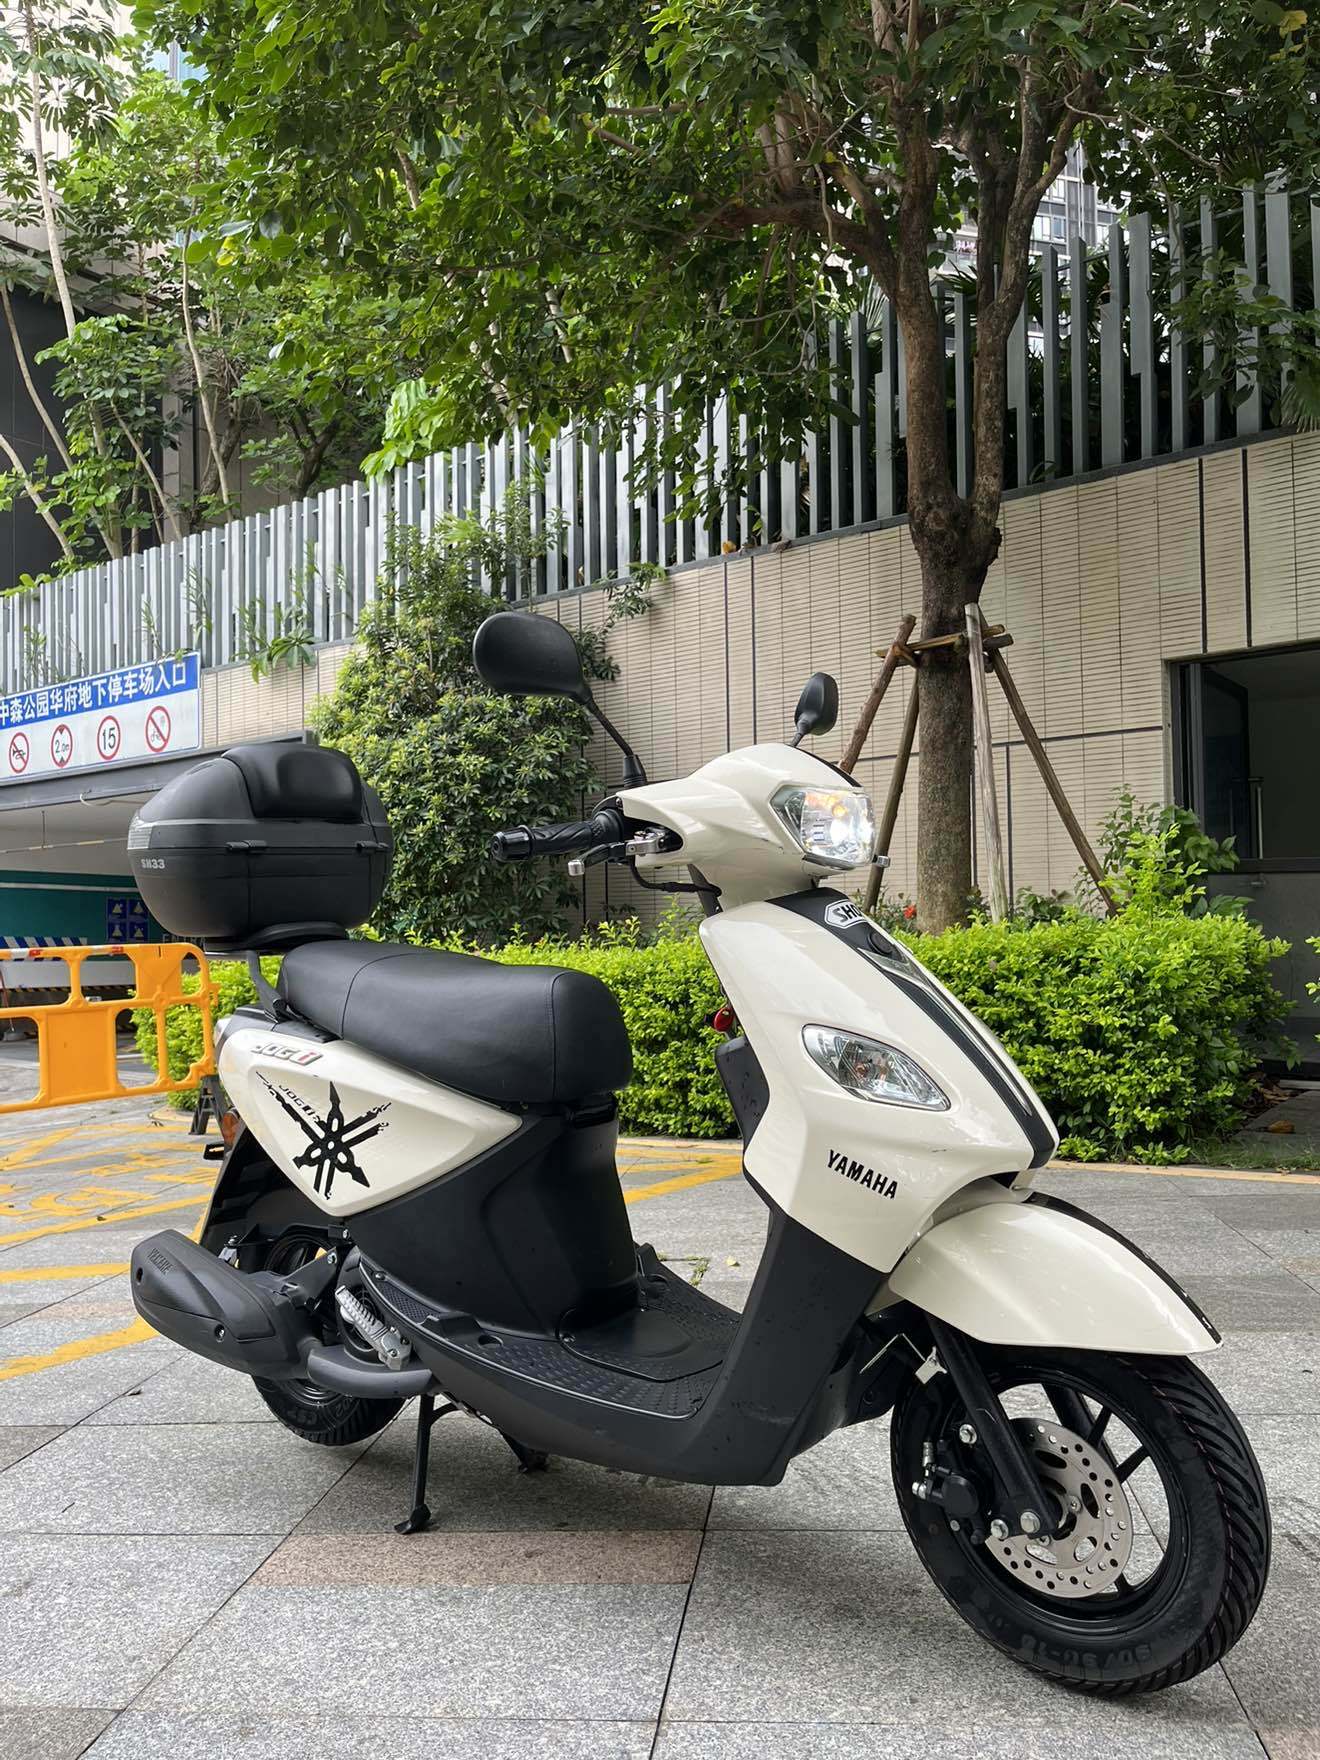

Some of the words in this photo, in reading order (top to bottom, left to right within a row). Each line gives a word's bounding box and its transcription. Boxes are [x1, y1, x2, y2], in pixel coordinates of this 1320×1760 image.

[0, 662, 187, 726] 中森公园华府地下停车场入口
[102, 727, 116, 750] 15
[827, 1149, 898, 1199] YAMAHA
